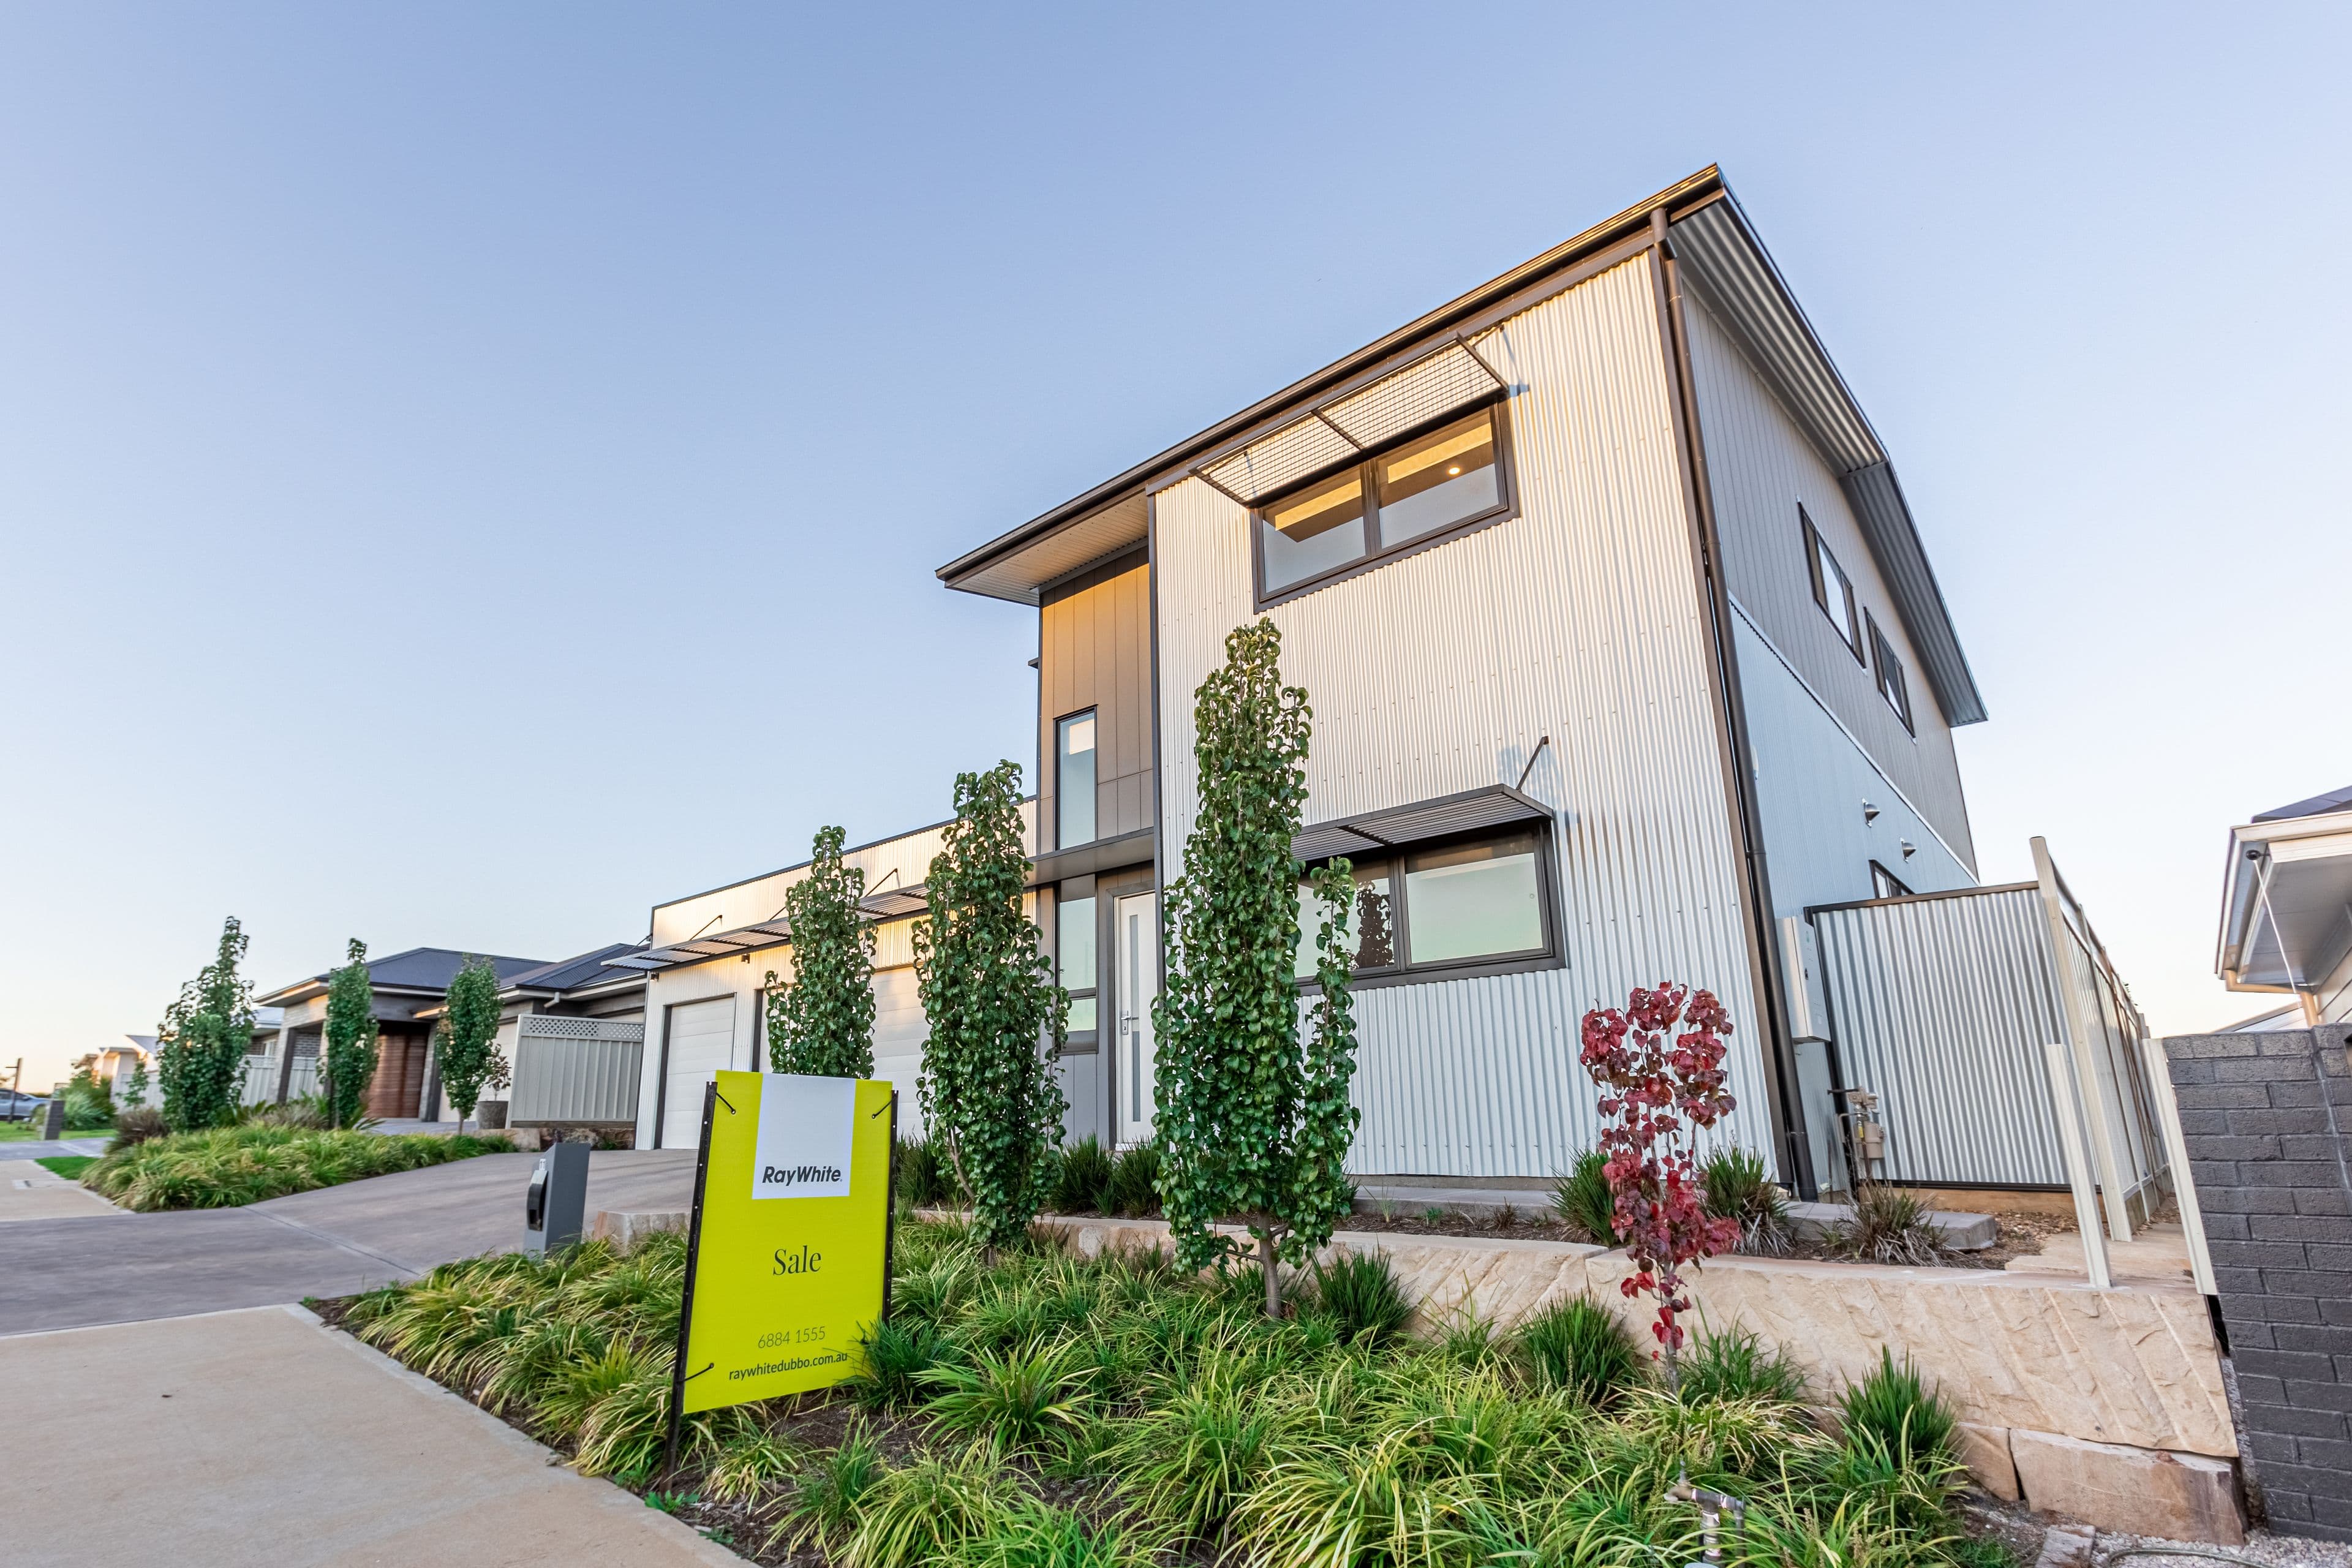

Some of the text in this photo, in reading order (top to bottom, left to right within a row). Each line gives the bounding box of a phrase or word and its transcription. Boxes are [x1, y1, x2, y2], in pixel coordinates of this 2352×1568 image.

[773, 1245, 821, 1276] Sale
[758, 1326, 826, 1349] 6884 1555
[729, 1352, 848, 1381] raywhitedubbo.com.au
